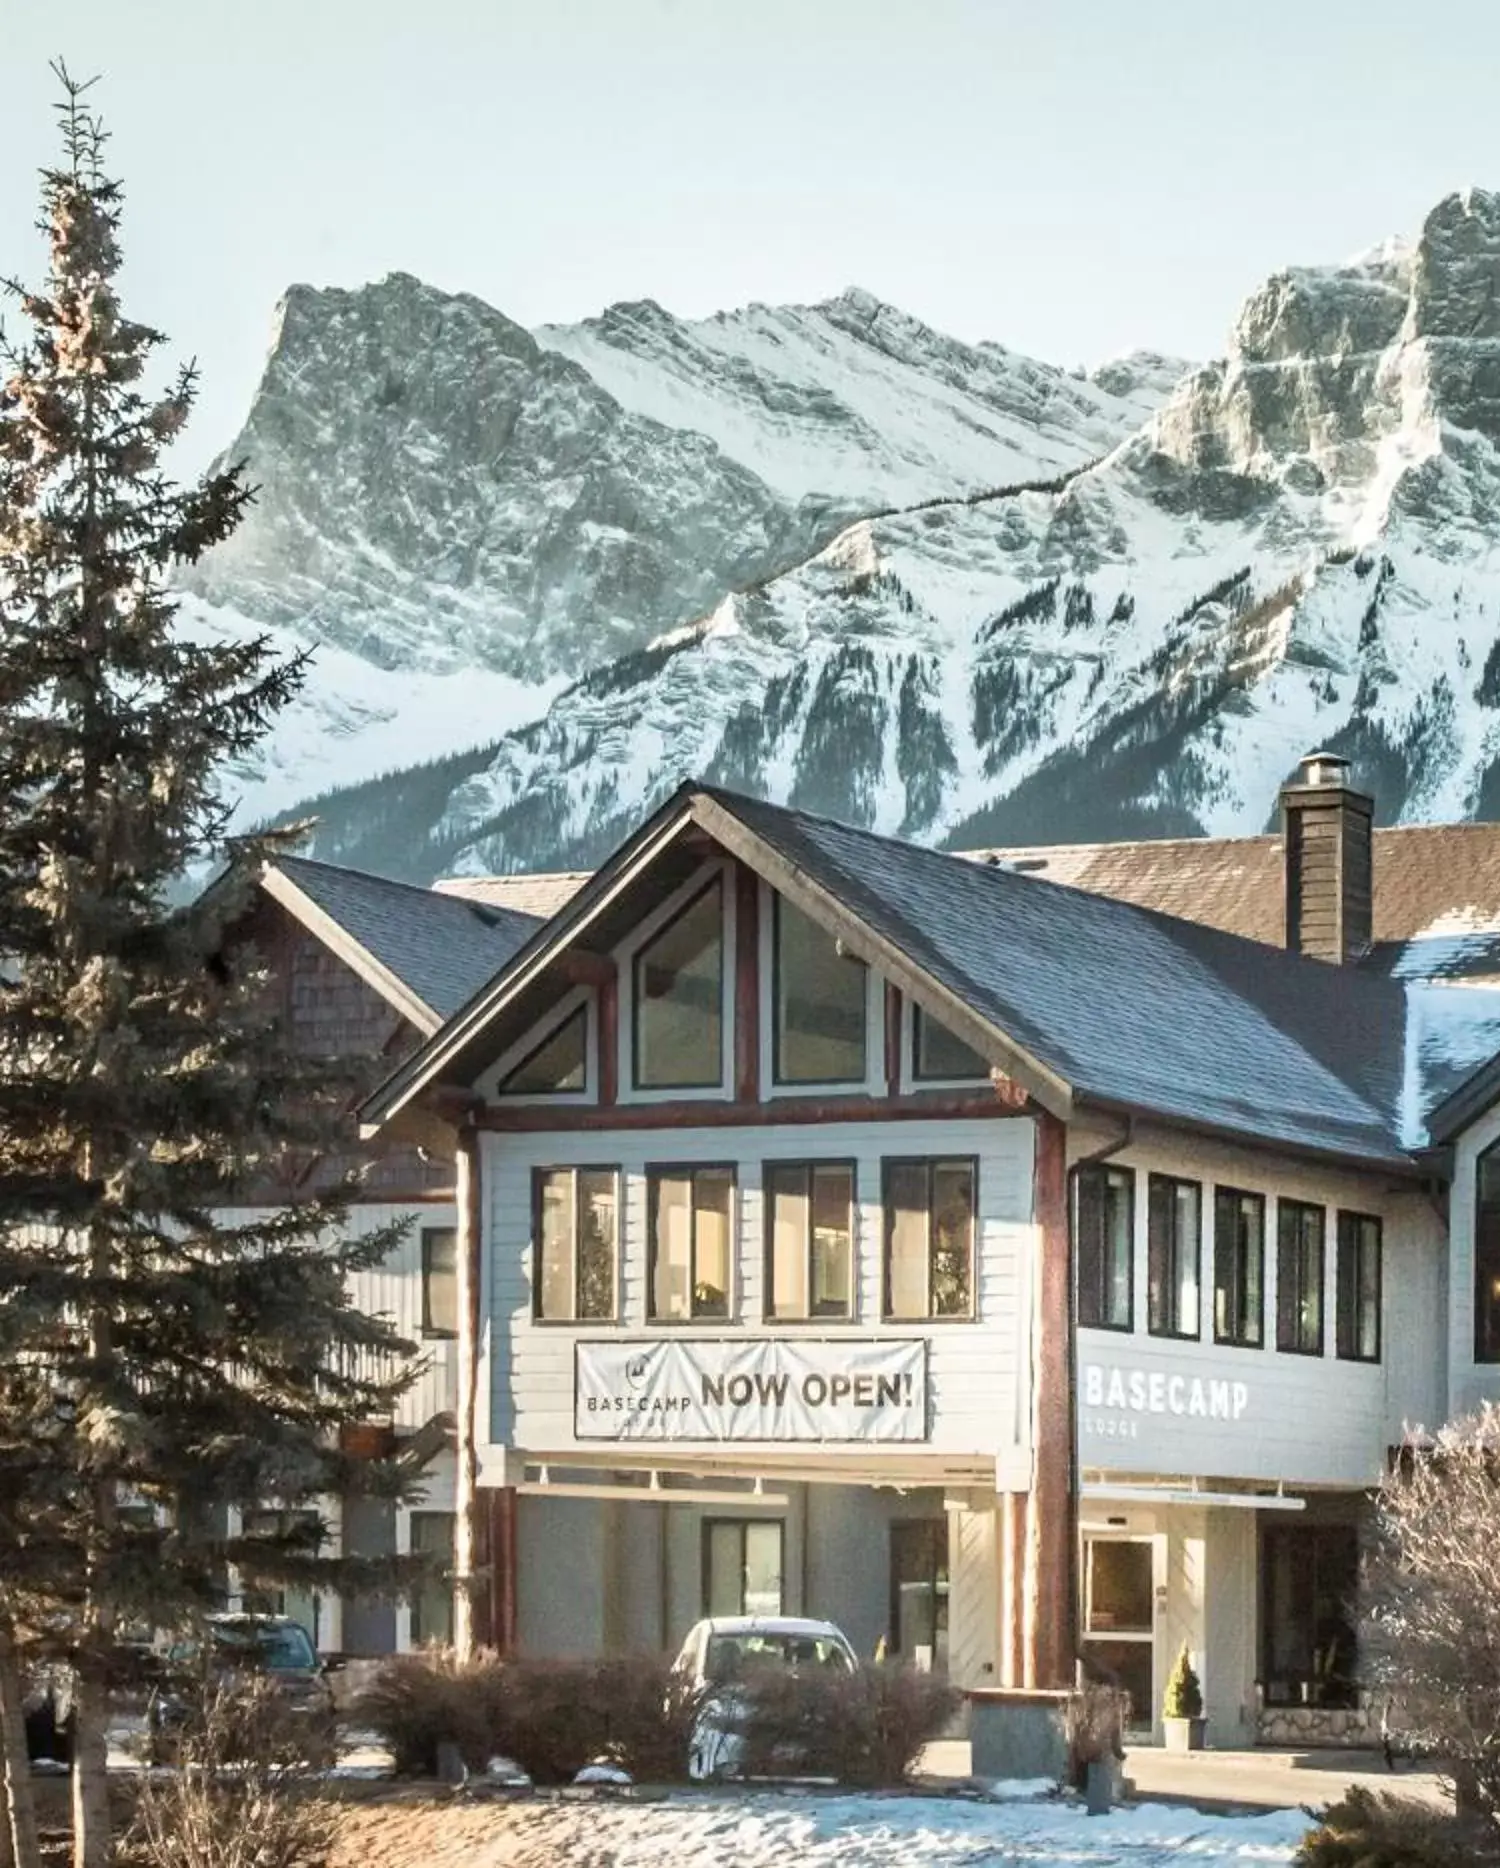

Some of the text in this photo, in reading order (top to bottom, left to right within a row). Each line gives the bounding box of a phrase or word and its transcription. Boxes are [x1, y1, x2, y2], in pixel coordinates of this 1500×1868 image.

[587, 1397, 691, 1412] BASECAMP
[701, 1373, 913, 1408] NOW OPEN!
[1085, 1364, 1249, 1420] BASECAMP
